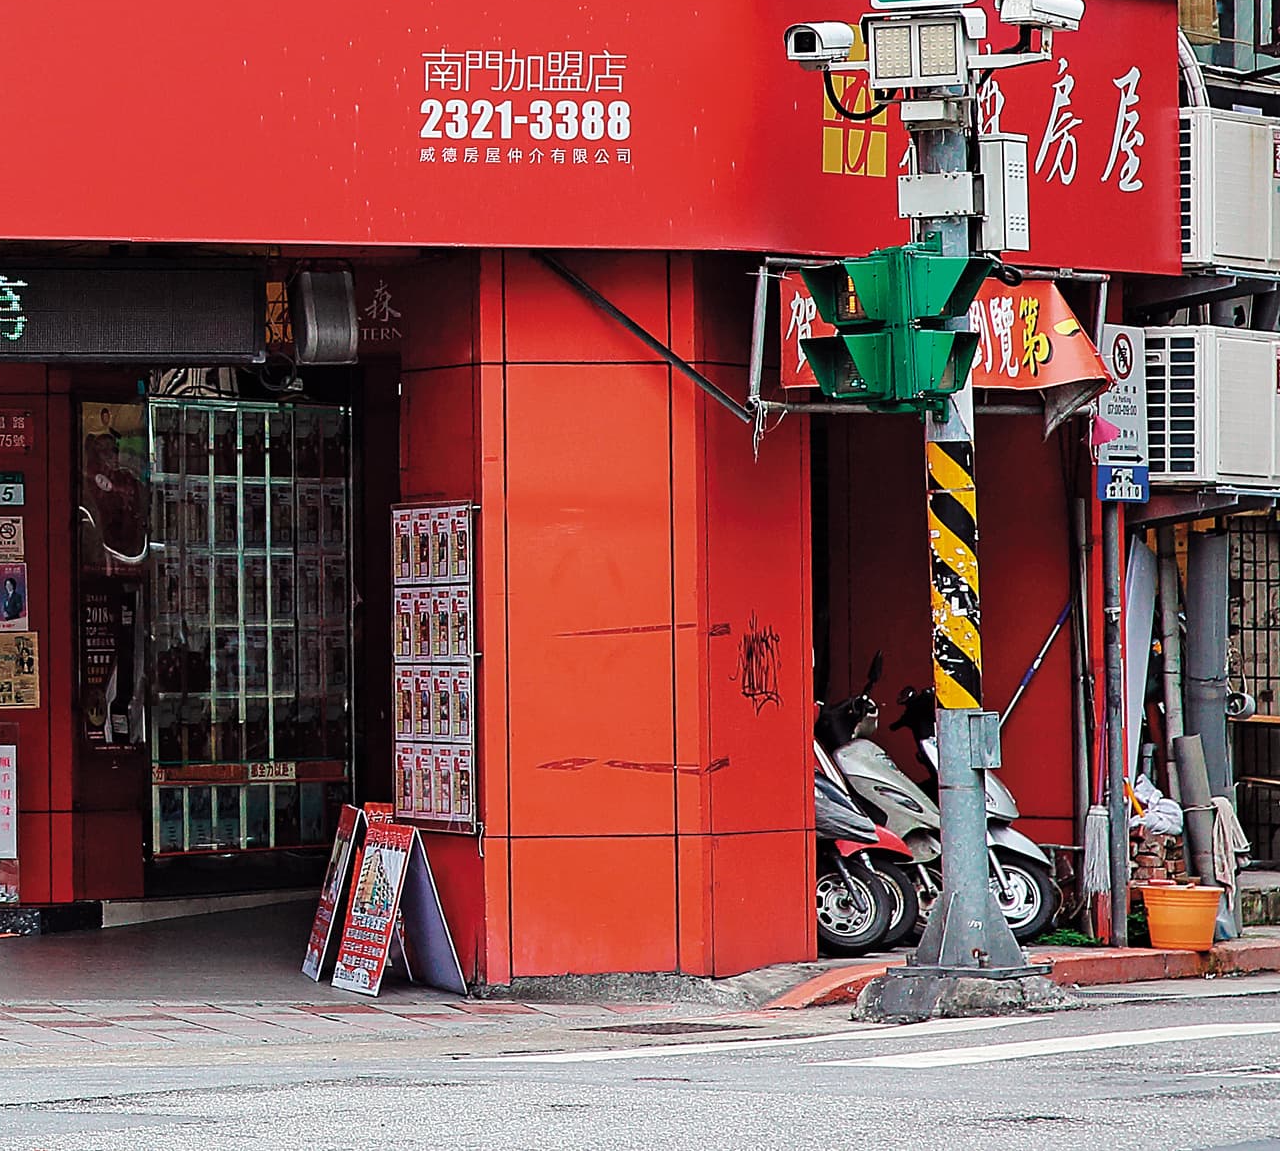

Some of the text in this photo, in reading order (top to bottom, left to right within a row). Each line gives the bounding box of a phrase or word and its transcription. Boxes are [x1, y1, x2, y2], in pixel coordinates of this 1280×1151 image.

[421, 48, 627, 92] 南門加盟店
[419, 98, 631, 140] 2321-3388
[419, 147, 631, 164] 威德房屋仲介有限公司
